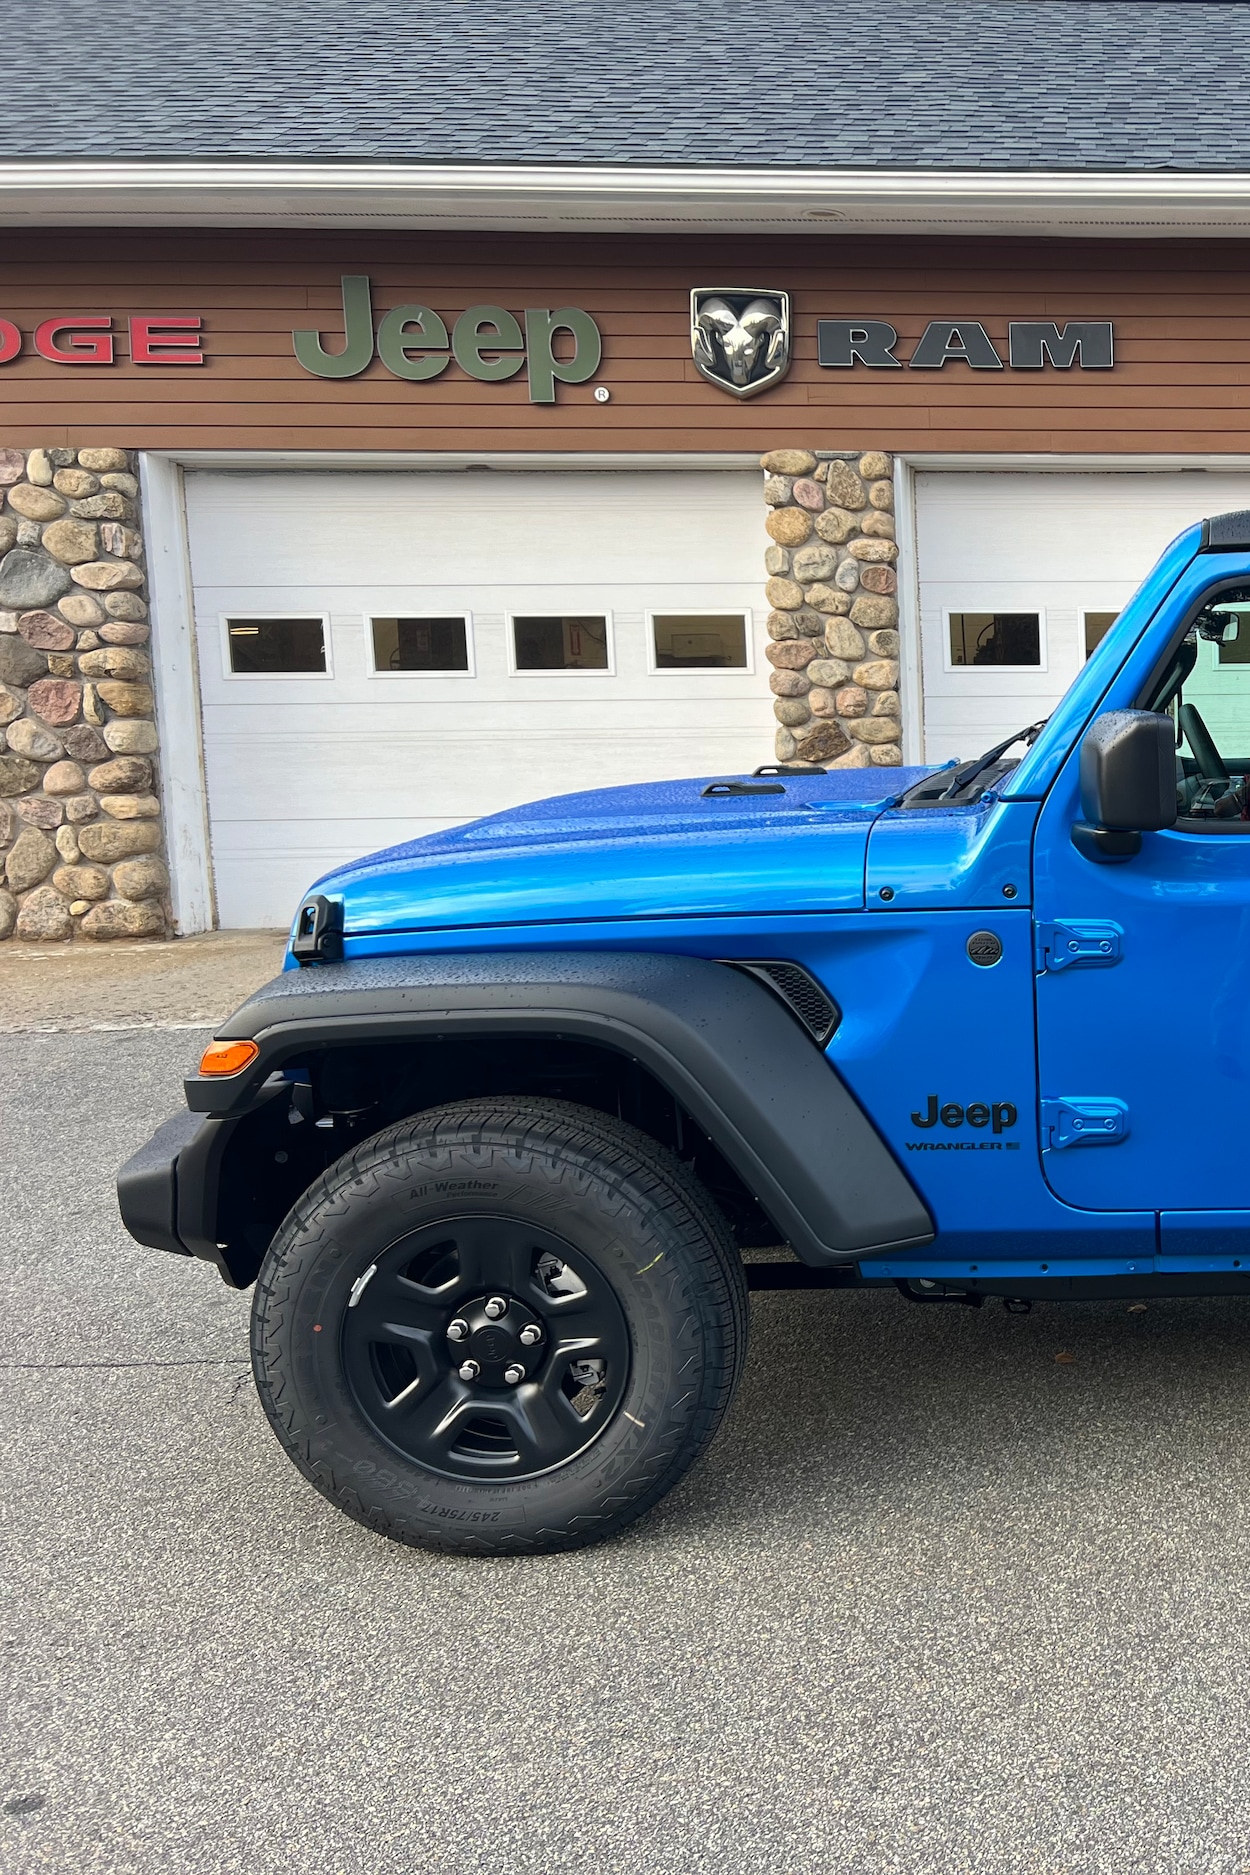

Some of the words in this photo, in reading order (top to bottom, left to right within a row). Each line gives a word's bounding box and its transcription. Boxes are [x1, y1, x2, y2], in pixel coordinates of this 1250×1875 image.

[0, 316, 205, 365] GE
[292, 275, 602, 403] Jeep
[816, 319, 1115, 369] RAM
[910, 1094, 1018, 1134] Jeep
[905, 1142, 1003, 1151] WRANGLER
[409, 1180, 499, 1200] All-Weather
[420, 1505, 502, 1523] 245/75R17
